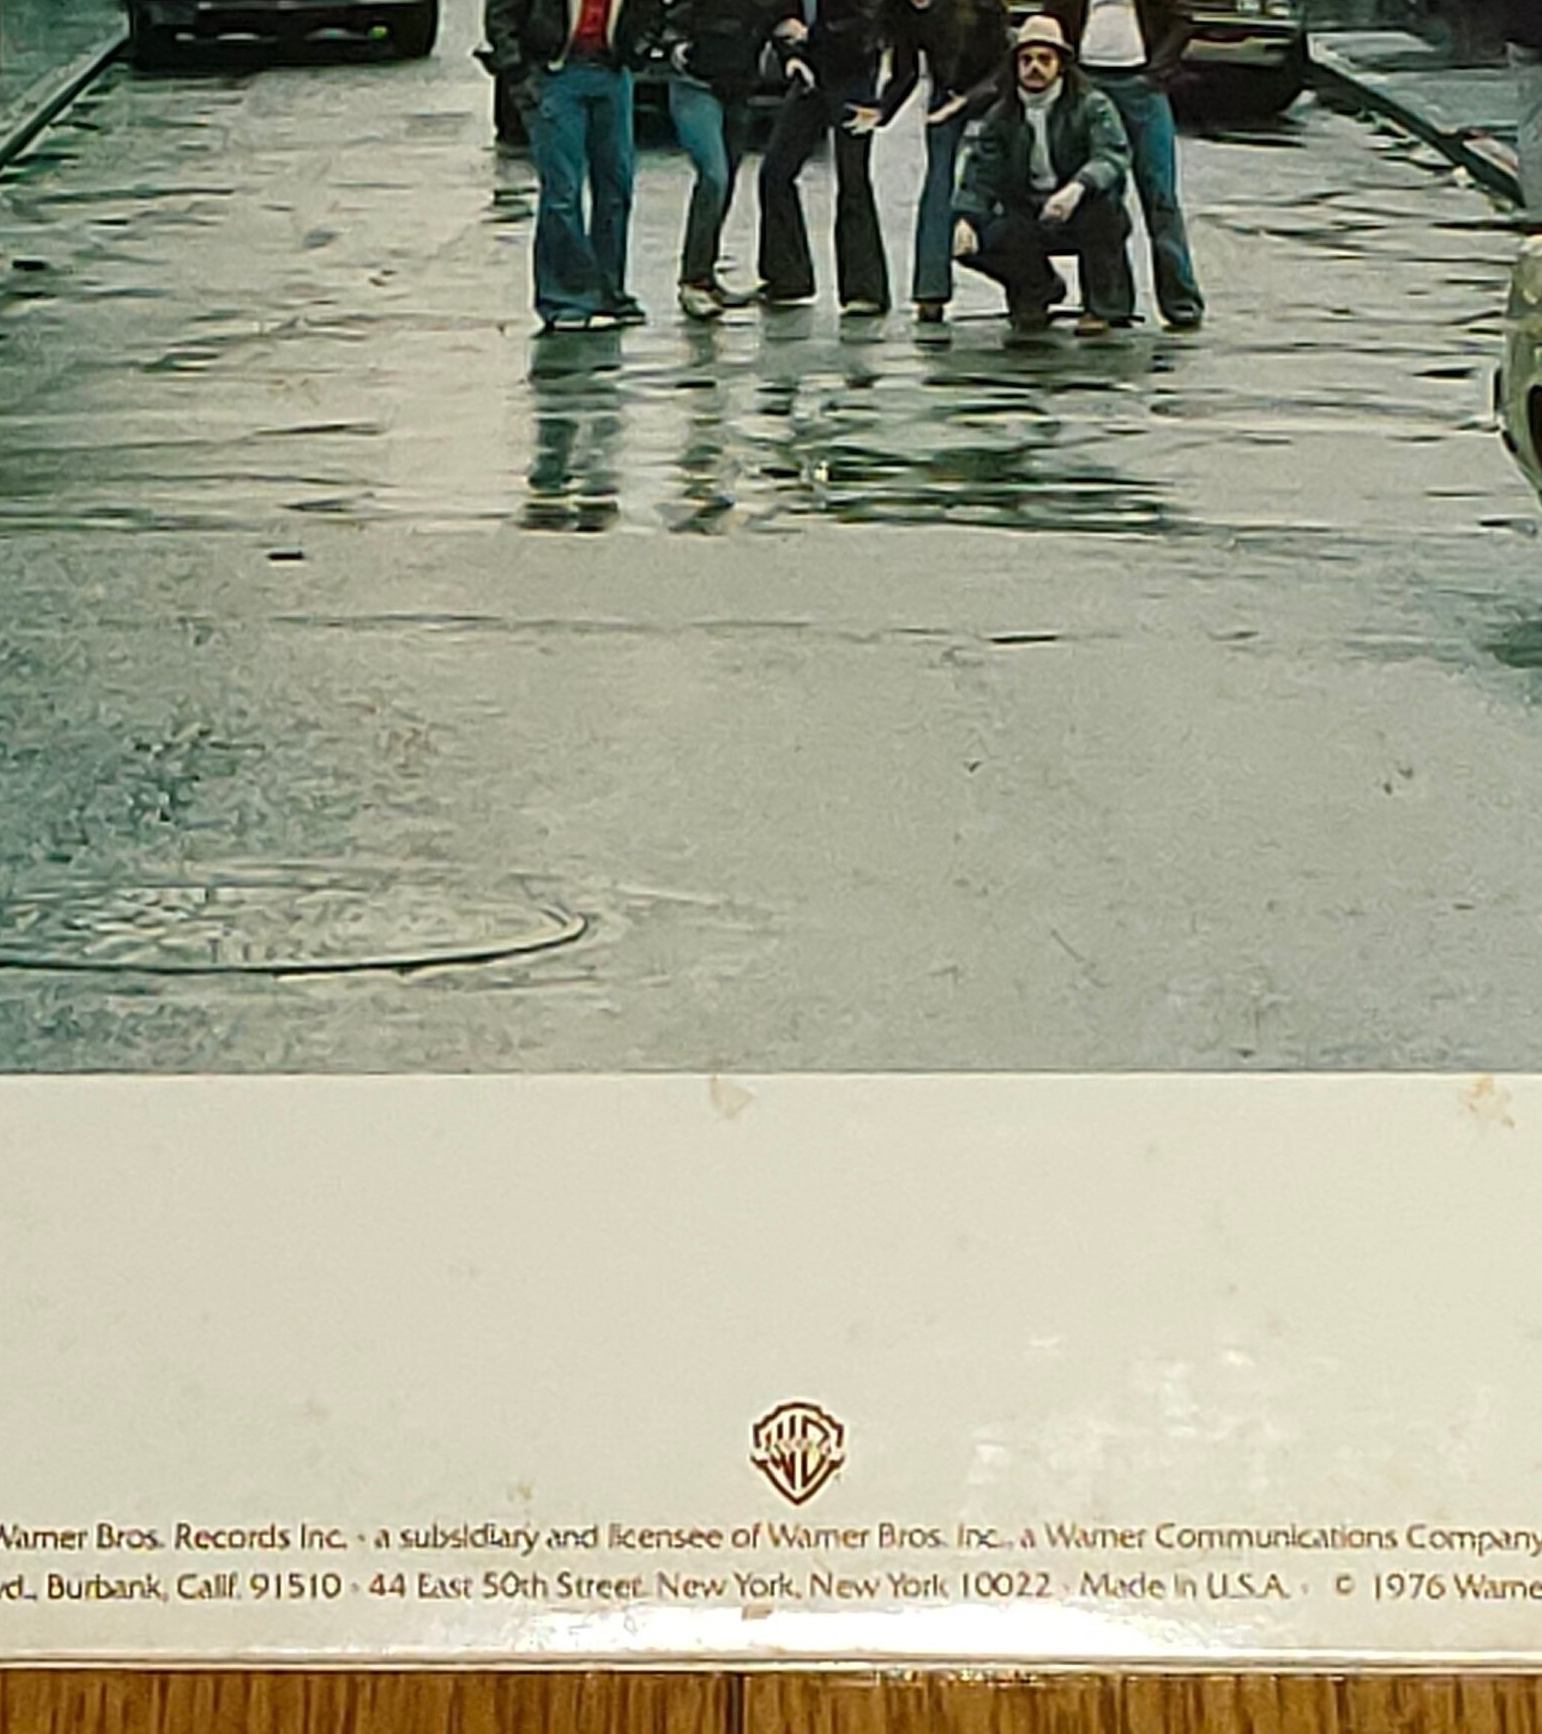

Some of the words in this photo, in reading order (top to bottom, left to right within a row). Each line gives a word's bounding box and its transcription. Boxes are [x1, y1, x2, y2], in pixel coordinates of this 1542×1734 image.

[96, 1523, 166, 1550] Bros.
[174, 1523, 291, 1550] Records
[300, 1523, 348, 1550] Inc.
[373, 1529, 391, 1550] a
[398, 1523, 540, 1556] subsidiary
[545, 1523, 598, 1549] and
[608, 1523, 724, 1549] licensee
[731, 1522, 762, 1549] of
[767, 1523, 871, 1549] Warner
[878, 1522, 948, 1549] Bros.
[1020, 1528, 1035, 1549] a
[1045, 1522, 1147, 1549] Warner
[1155, 1522, 1399, 1550] Communications
[46, 1572, 169, 1603] Burbank,
[175, 1572, 244, 1600] Calif.
[250, 1572, 342, 1600] 91510
[368, 1572, 408, 1599] 44
[416, 1572, 473, 1599] East
[481, 1571, 550, 1599] 50th
[658, 1572, 727, 1598] New
[809, 1571, 878, 1599] New
[886, 1571, 951, 1599] York
[960, 1571, 1053, 1599] 10022
[1079, 1571, 1166, 1599] Made
[1173, 1572, 1198, 1599] in
[1371, 1573, 1447, 1601] 1976
